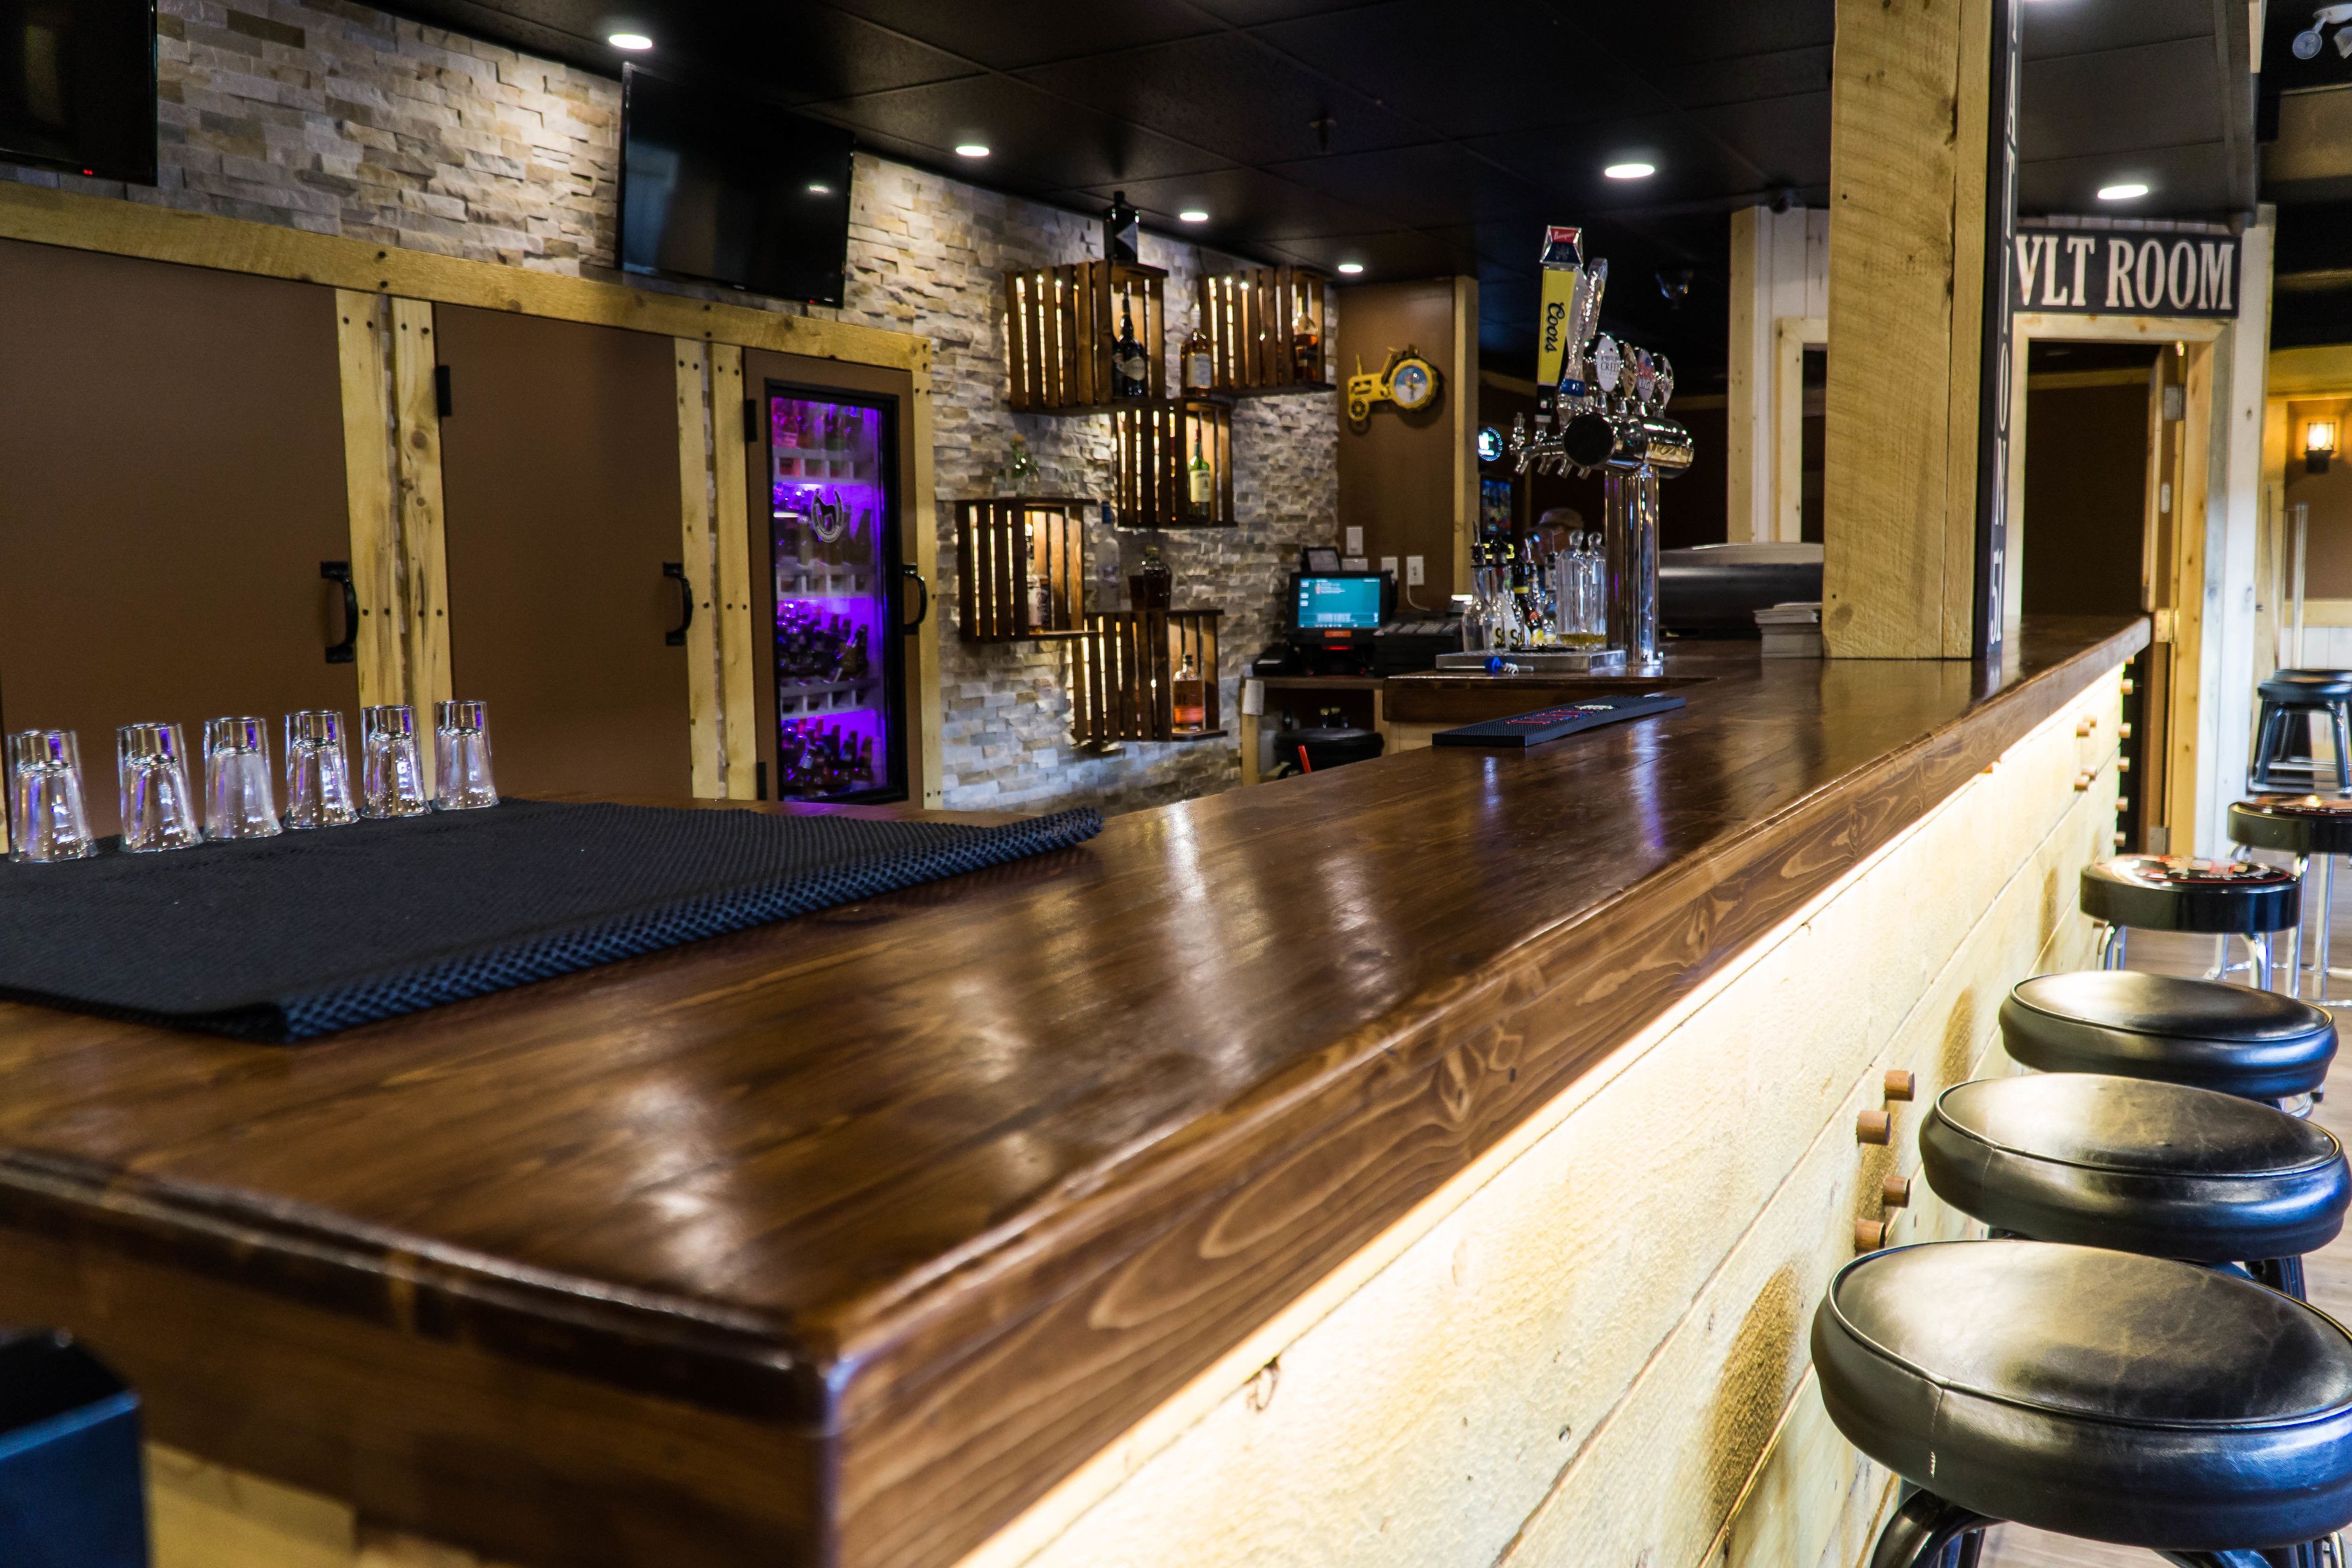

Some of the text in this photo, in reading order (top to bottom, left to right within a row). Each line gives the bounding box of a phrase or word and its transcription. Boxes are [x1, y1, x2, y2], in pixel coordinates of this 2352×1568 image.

[2016, 235, 2234, 310] VLT ROOM
[1544, 302, 1565, 353] Coors
[1990, 548, 2003, 645] 51
